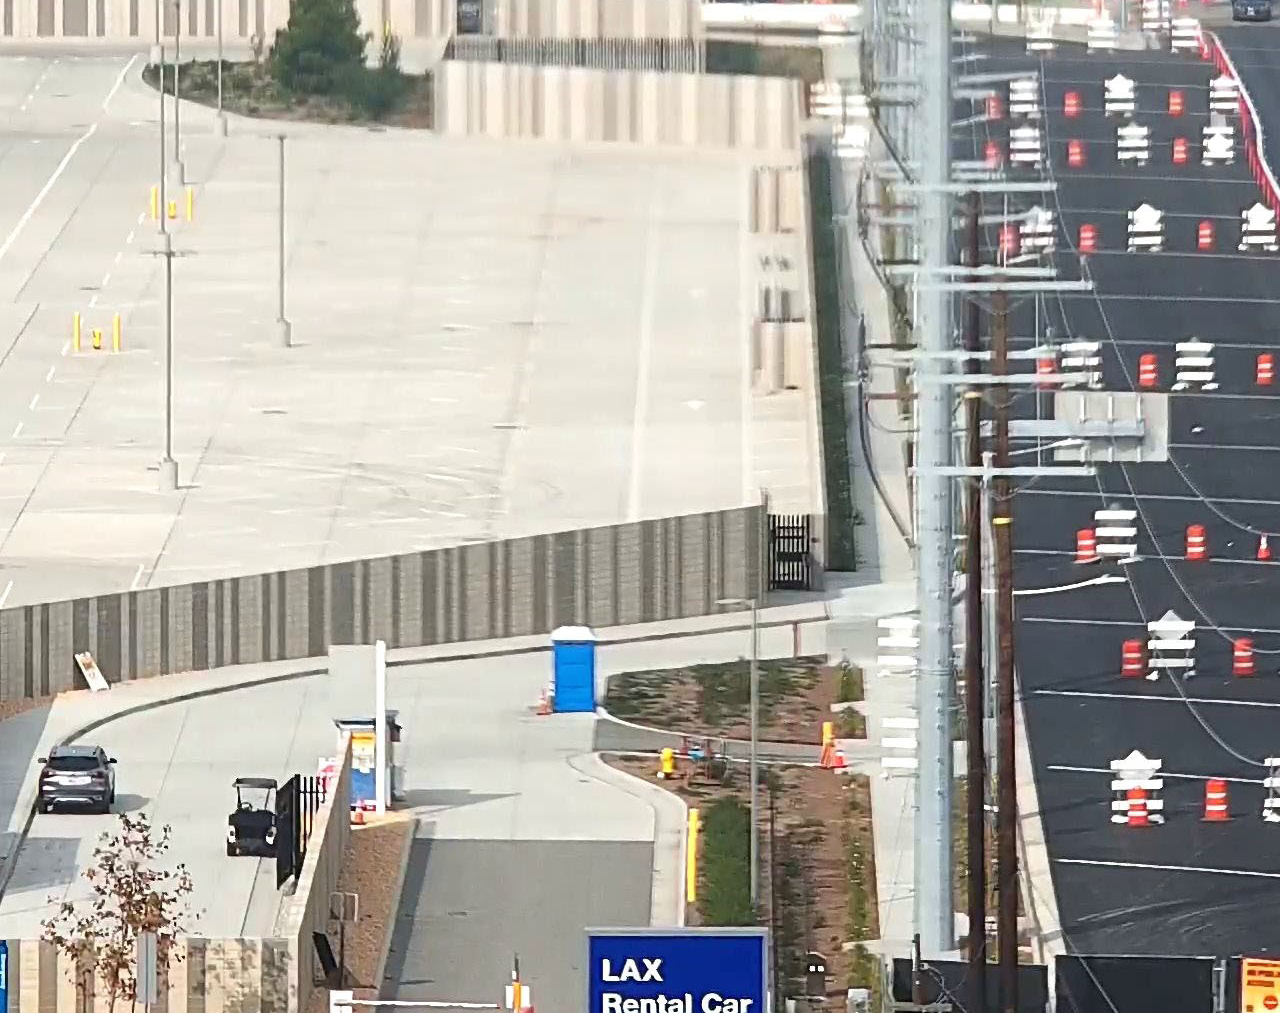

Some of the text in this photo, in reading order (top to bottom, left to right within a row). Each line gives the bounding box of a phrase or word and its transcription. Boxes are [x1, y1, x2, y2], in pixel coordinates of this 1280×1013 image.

[602, 958, 663, 981] LAX
[601, 992, 754, 1013] Rental Car
